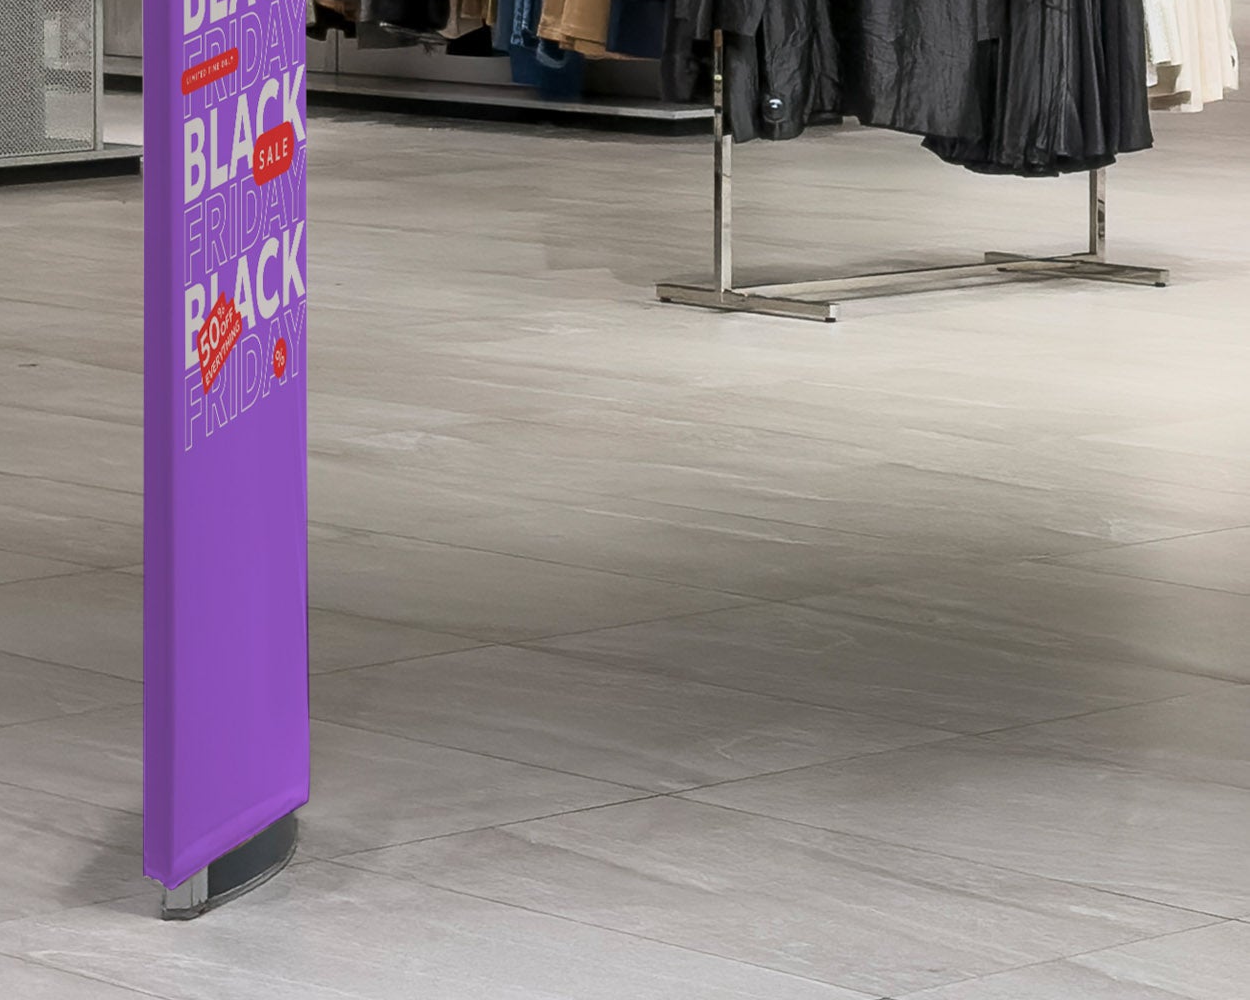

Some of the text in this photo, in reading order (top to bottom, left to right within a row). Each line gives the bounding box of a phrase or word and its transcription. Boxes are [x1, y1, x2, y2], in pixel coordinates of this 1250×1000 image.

[258, 136, 288, 170] SALE
[220, 306, 233, 335] OFF
[204, 320, 240, 386] EVERYTHING
